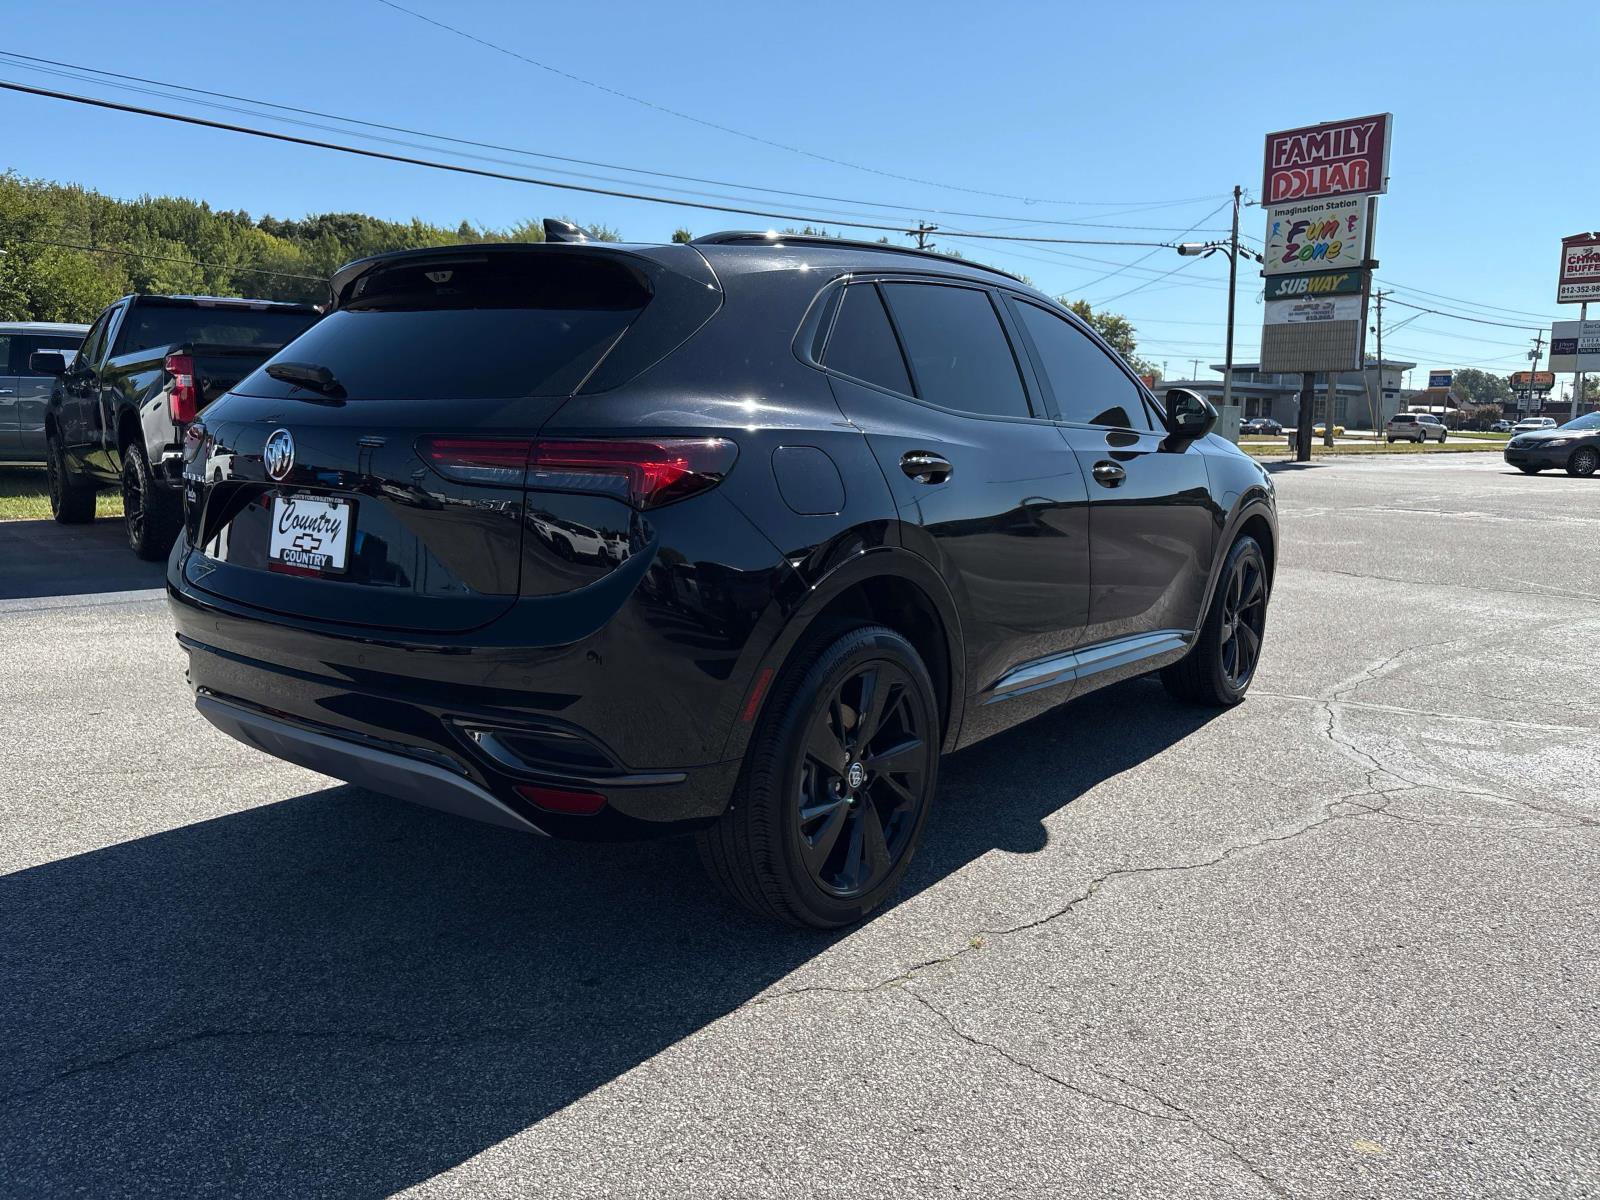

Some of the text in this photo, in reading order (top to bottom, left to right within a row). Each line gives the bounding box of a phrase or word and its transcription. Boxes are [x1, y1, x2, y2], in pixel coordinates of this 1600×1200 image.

[1272, 122, 1377, 168] FAMILY
[1270, 159, 1369, 202] DOLLAR
[1274, 200, 1358, 217] Imagination Station
[1286, 219, 1340, 243] Fun
[1275, 273, 1350, 295] SUBWAY
[278, 501, 344, 543] Country
[283, 549, 328, 567] COUNTRY
